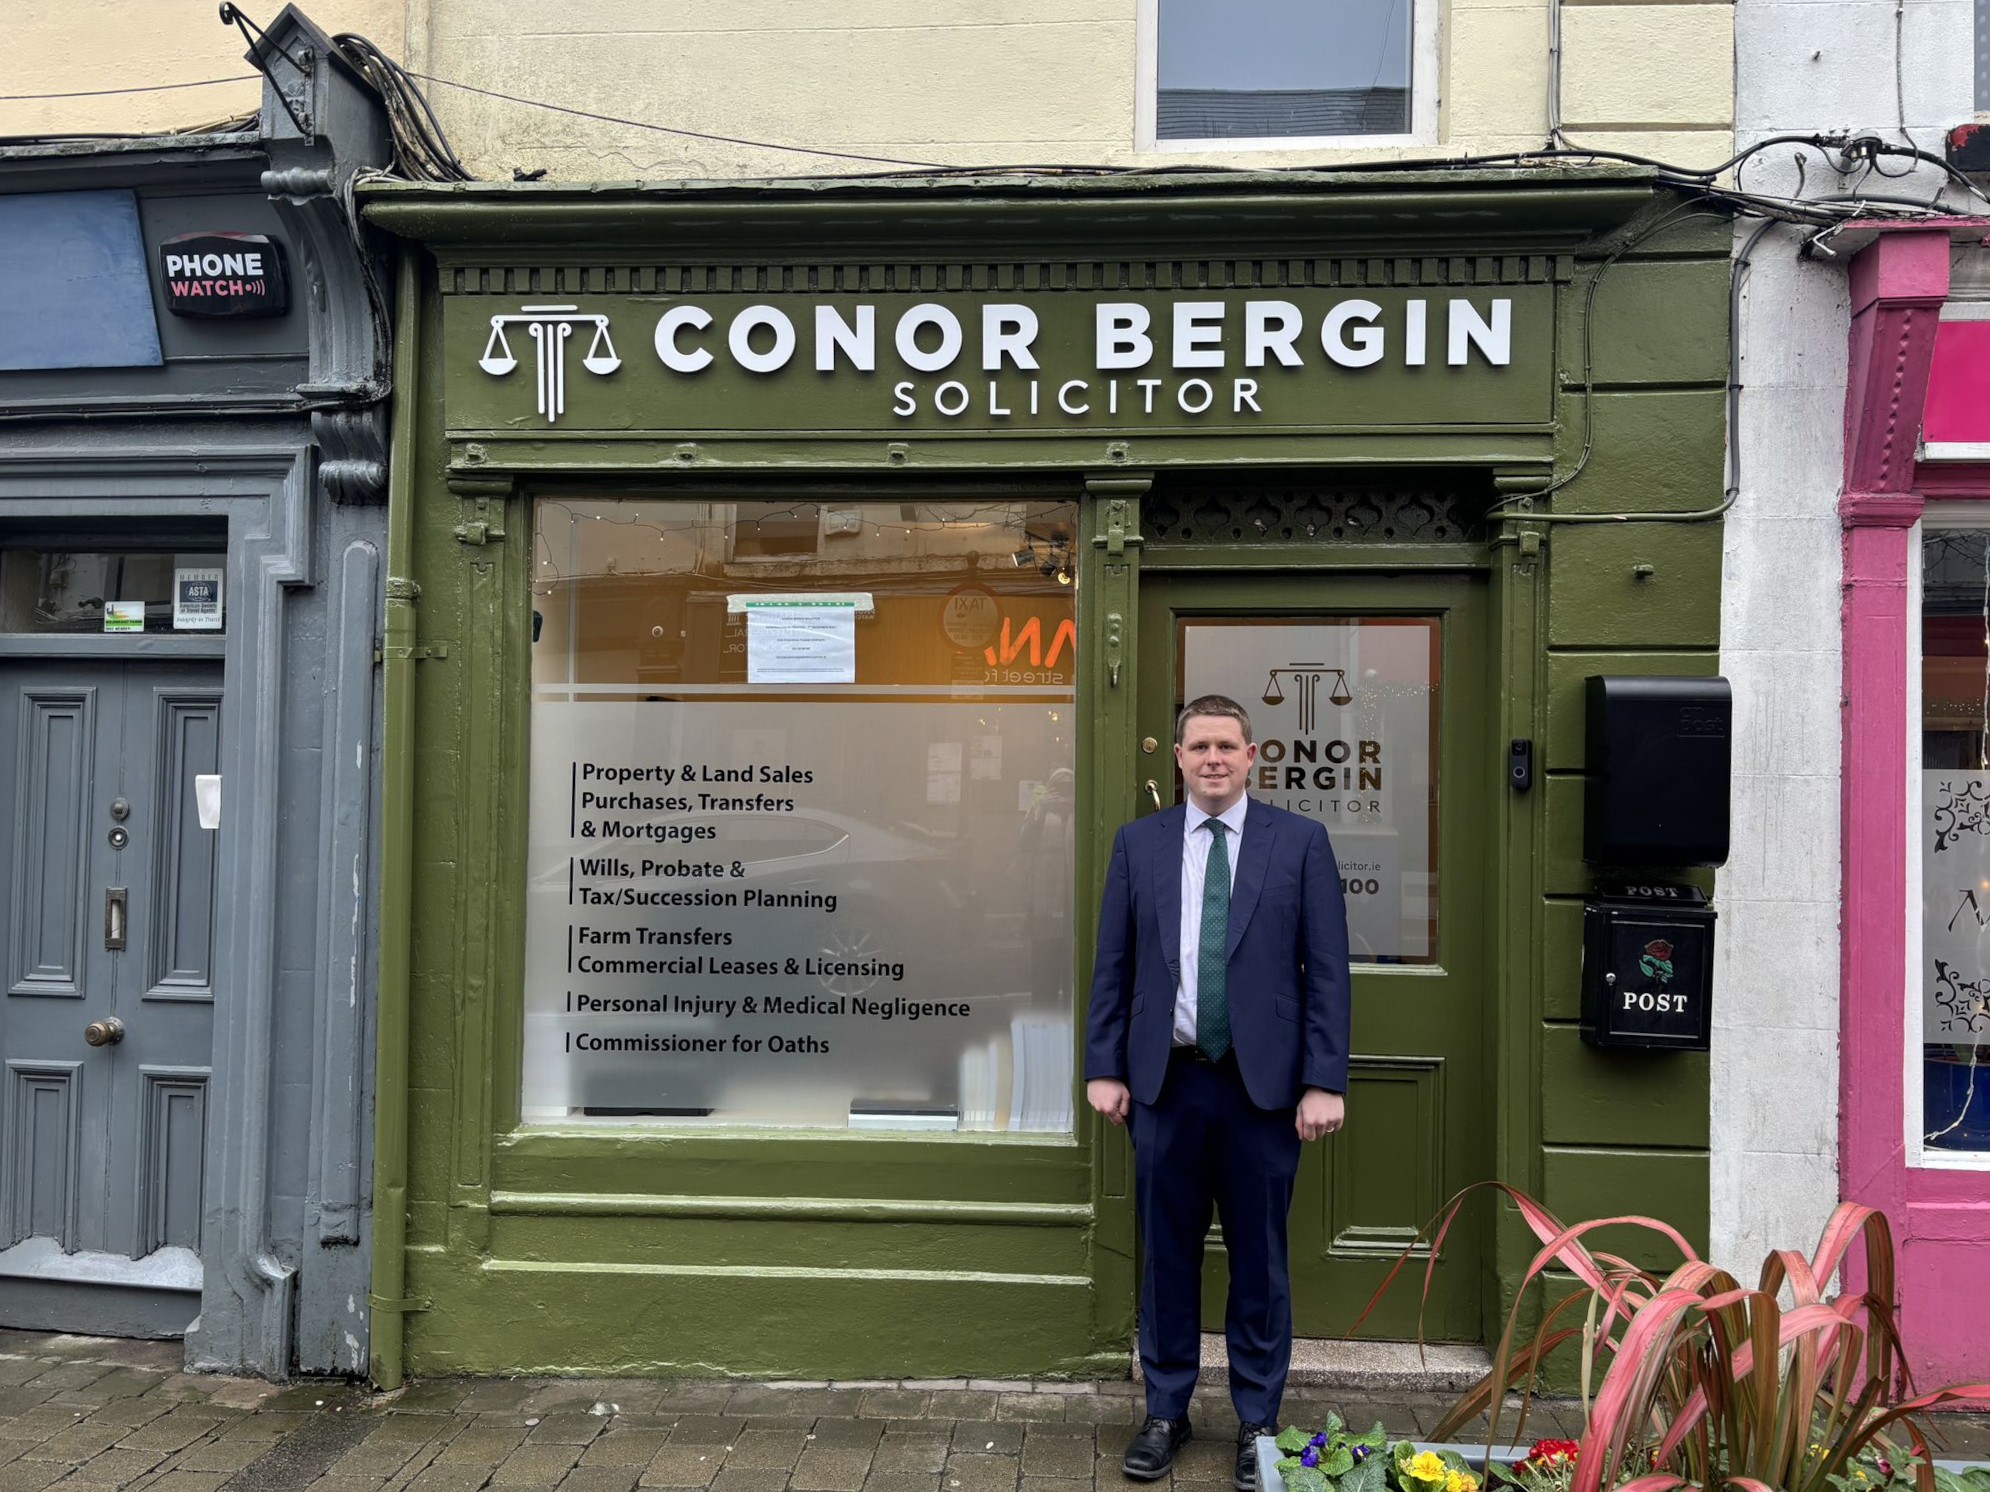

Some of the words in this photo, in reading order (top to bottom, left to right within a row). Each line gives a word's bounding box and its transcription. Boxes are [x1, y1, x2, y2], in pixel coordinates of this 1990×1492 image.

[166, 253, 264, 277] PHONE
[170, 280, 244, 297] WATCH
[654, 303, 1040, 373] CONOR
[1096, 299, 1512, 369] BERGIN
[893, 379, 1263, 416] SOLICITOR
[188, 586, 209, 597] ASTA
[1259, 739, 1381, 764] ONOR
[582, 763, 675, 786] Property
[681, 764, 697, 782] &
[702, 765, 753, 783] Land
[759, 765, 813, 784] Sales
[1245, 766, 1382, 790] ERGIN
[582, 792, 693, 812] Purchases,
[698, 793, 794, 812] Transfers
[1256, 799, 1381, 812] ICITOR
[581, 820, 596, 838] &
[602, 821, 716, 843] Mortgages
[580, 858, 635, 879] Wills,
[641, 859, 724, 877] Probate
[730, 861, 745, 878] &
[1337, 860, 1381, 871] licitor.ie
[1341, 878, 1379, 894] 100
[1625, 885, 1679, 897] POST
[579, 887, 737, 907] Tax/Succession
[743, 889, 837, 913] Planning
[578, 927, 631, 944] Farm
[636, 927, 732, 945] Transfers
[578, 956, 702, 975] Commercial
[709, 957, 778, 976] Leases
[784, 958, 799, 976] &
[805, 958, 904, 981] Licensing
[577, 994, 667, 1013] Personal
[674, 995, 737, 1019] Injury
[742, 996, 757, 1014] &
[763, 995, 845, 1015] Medical
[852, 996, 971, 1020] Negligence
[1623, 992, 1687, 1012] POST
[576, 1033, 727, 1053] Commissioner
[732, 1034, 762, 1053] for
[768, 1035, 830, 1054] Oaths
